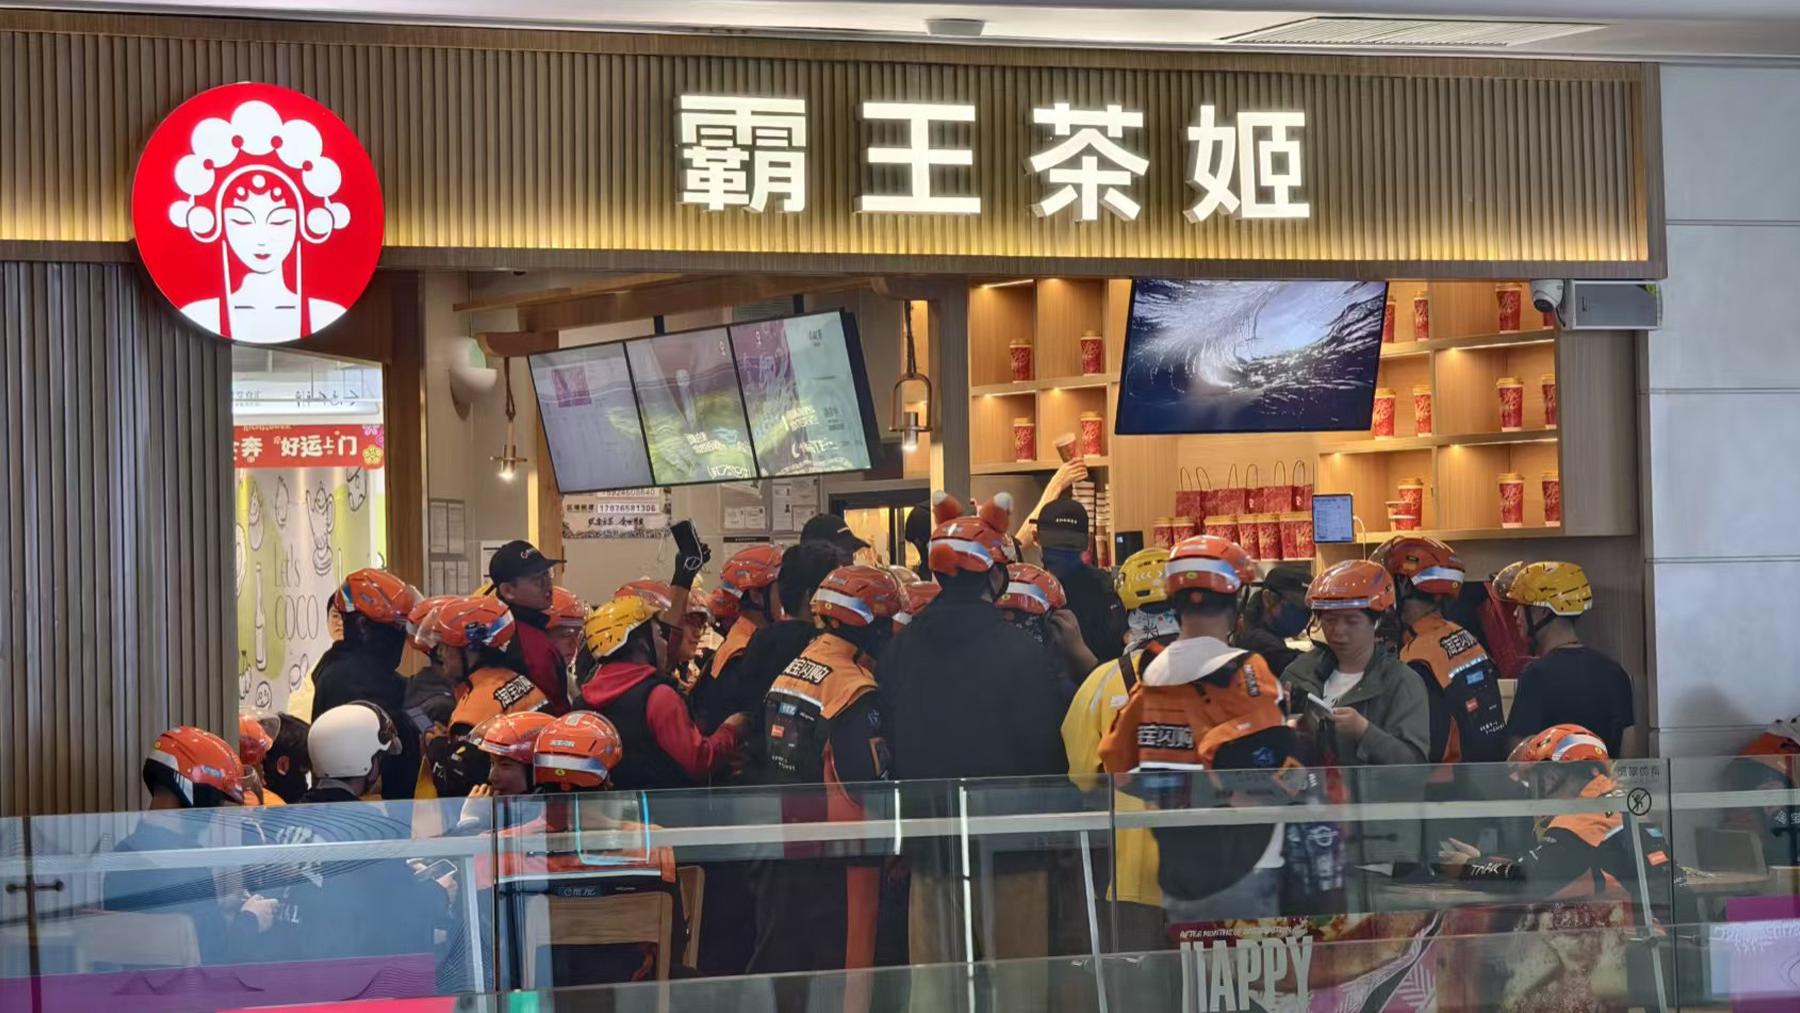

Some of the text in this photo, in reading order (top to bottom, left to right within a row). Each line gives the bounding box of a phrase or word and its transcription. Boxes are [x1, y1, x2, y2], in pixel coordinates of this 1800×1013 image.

[680, 94, 1311, 222] 霸王茶姬
[274, 543, 301, 588] Let's
